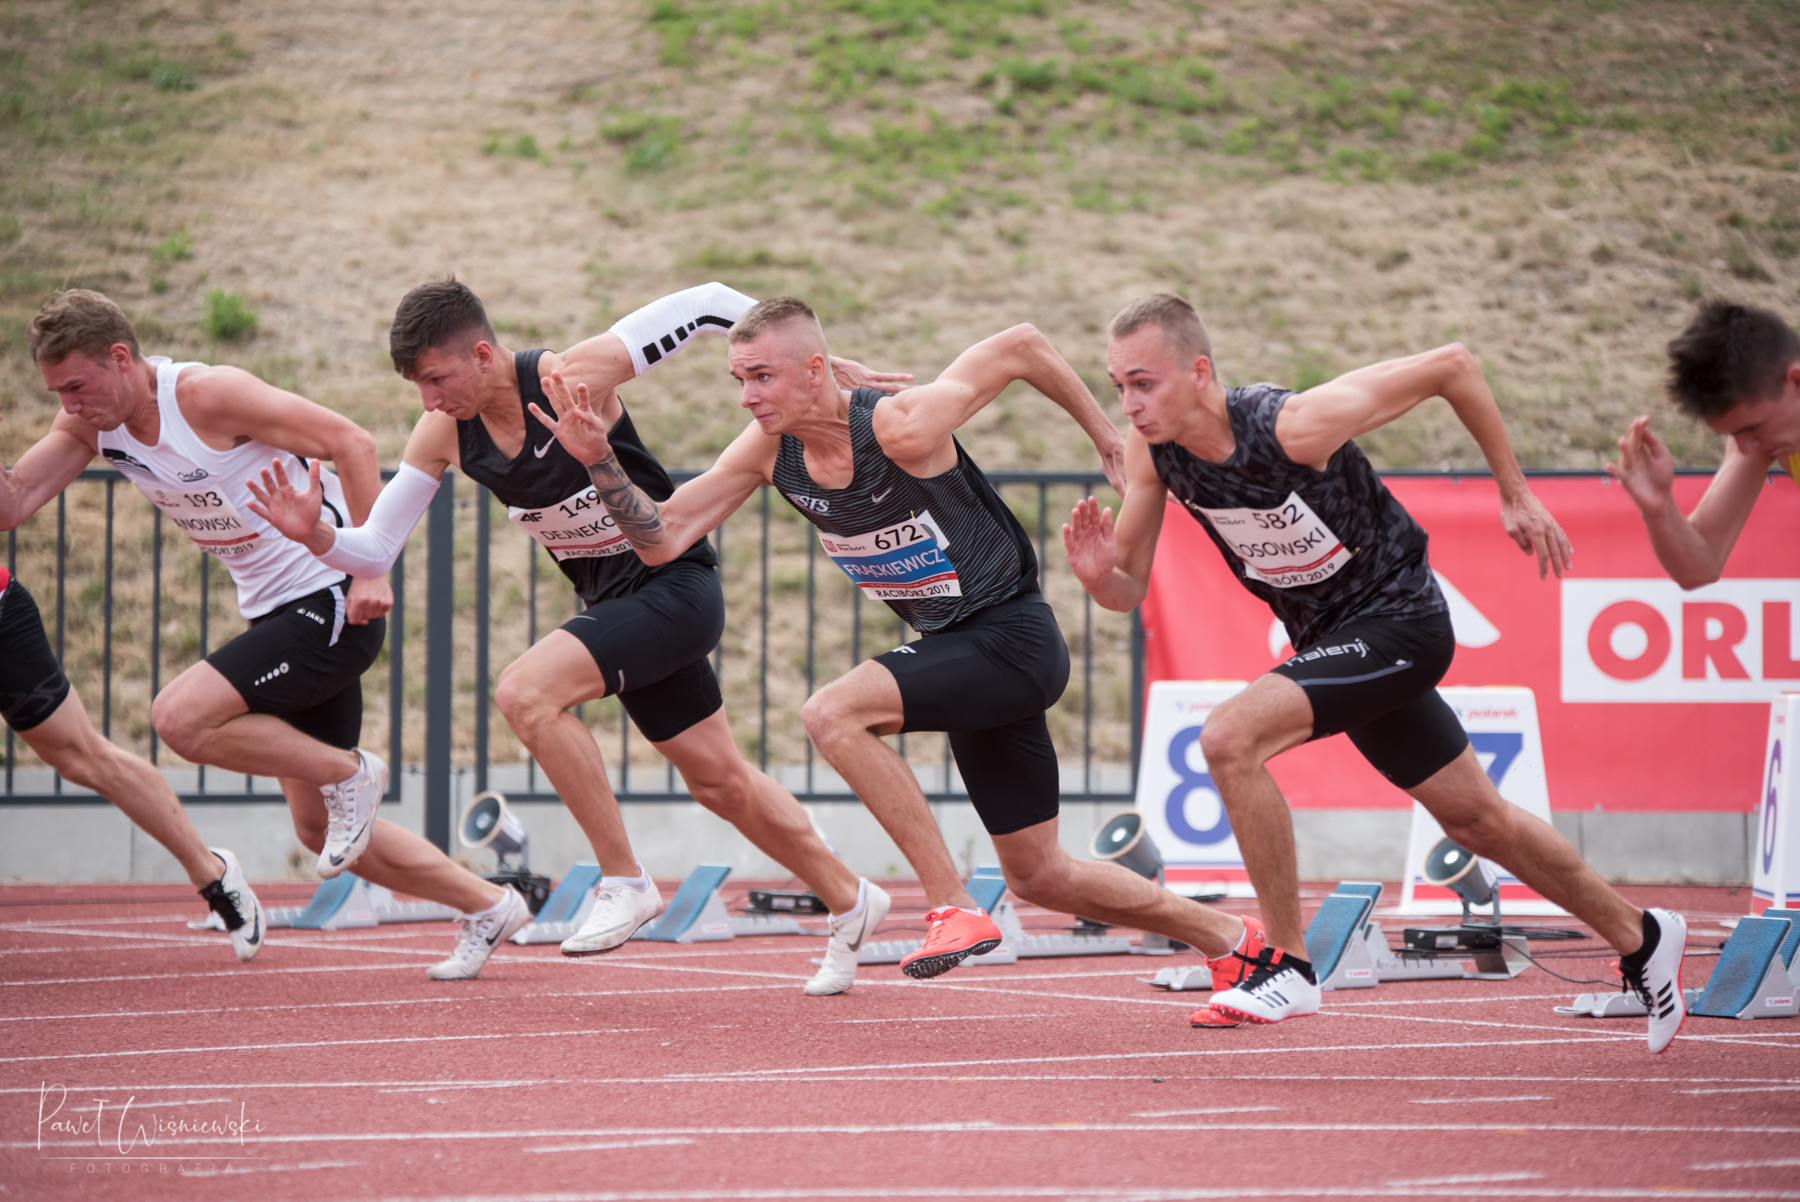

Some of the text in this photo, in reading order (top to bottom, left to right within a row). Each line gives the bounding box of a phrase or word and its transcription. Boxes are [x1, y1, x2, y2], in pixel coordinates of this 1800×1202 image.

[184, 491, 223, 507] 193
[559, 490, 601, 519] 149
[799, 495, 830, 512] STS
[520, 512, 543, 522] 4F
[1252, 503, 1305, 529] 582
[874, 524, 923, 550] 672
[1232, 527, 1326, 558] OSOWSKI
[231, 542, 254, 554] 2019
[564, 548, 613, 557] RACIBÓRZ
[613, 541, 632, 552] 201
[1306, 563, 1335, 583] 2019
[875, 584, 950, 598] RACIBÓRZ 2019
[305, 611, 325, 625] JAKO
[1465, 732, 1523, 790] 7
[1165, 725, 1233, 846] 8
[1763, 738, 1782, 876] 6
